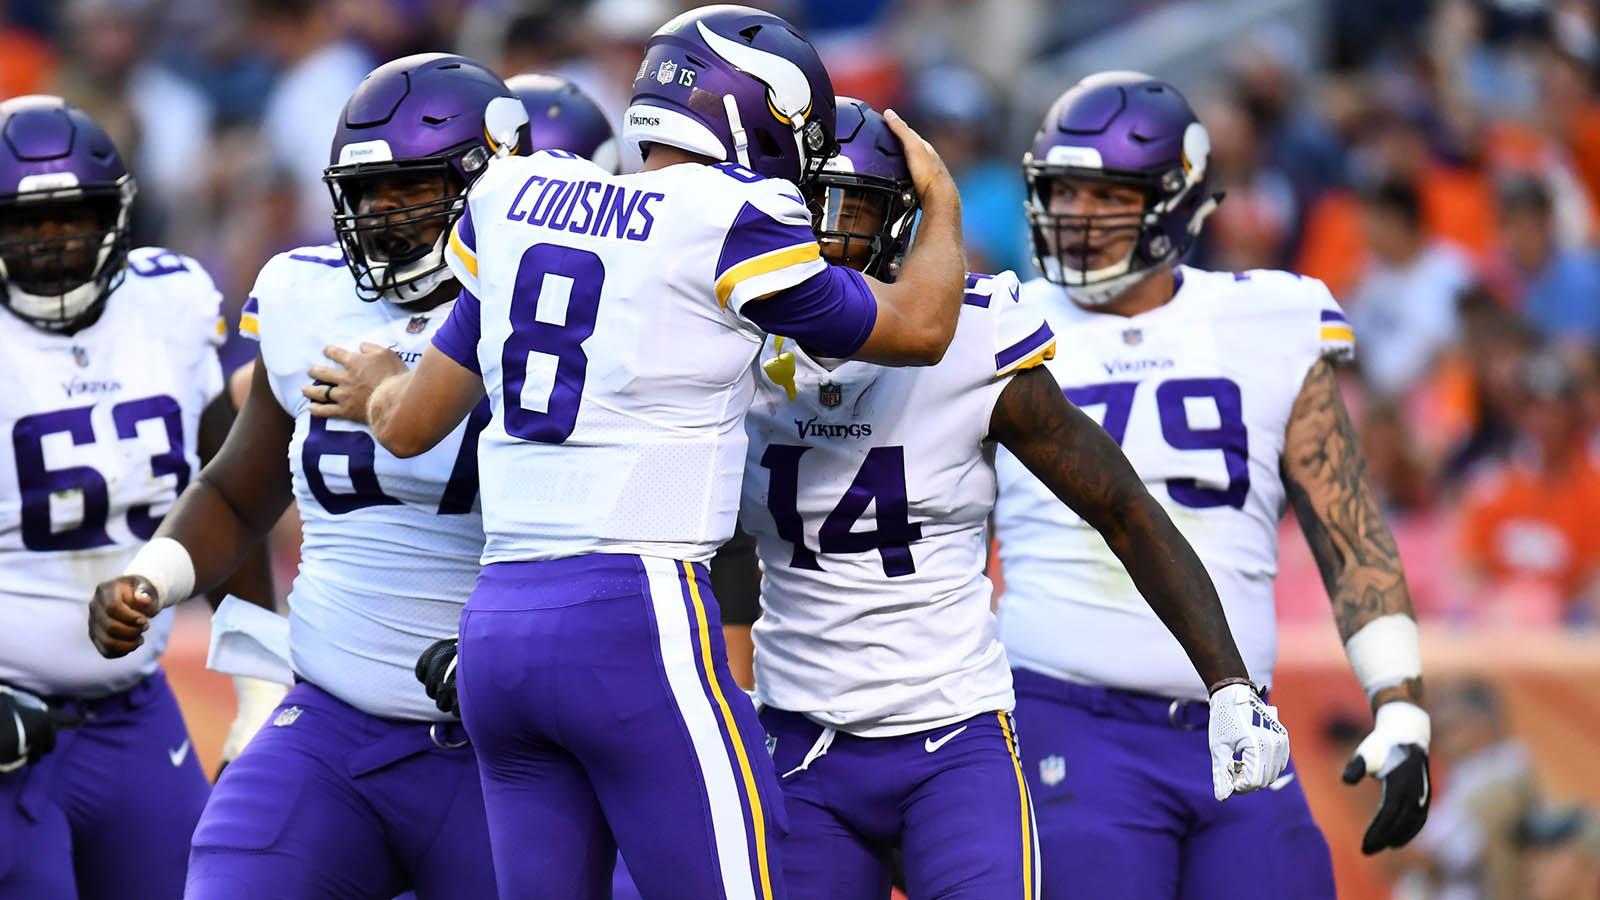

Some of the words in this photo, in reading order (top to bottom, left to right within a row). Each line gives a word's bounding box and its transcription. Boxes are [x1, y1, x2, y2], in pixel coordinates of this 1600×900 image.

[678, 68, 696, 87] TS
[506, 174, 665, 242] COUSINS
[501, 242, 606, 443] 8
[12, 394, 191, 551] 63
[760, 443, 923, 578] 14
[1062, 377, 1250, 510] 79
